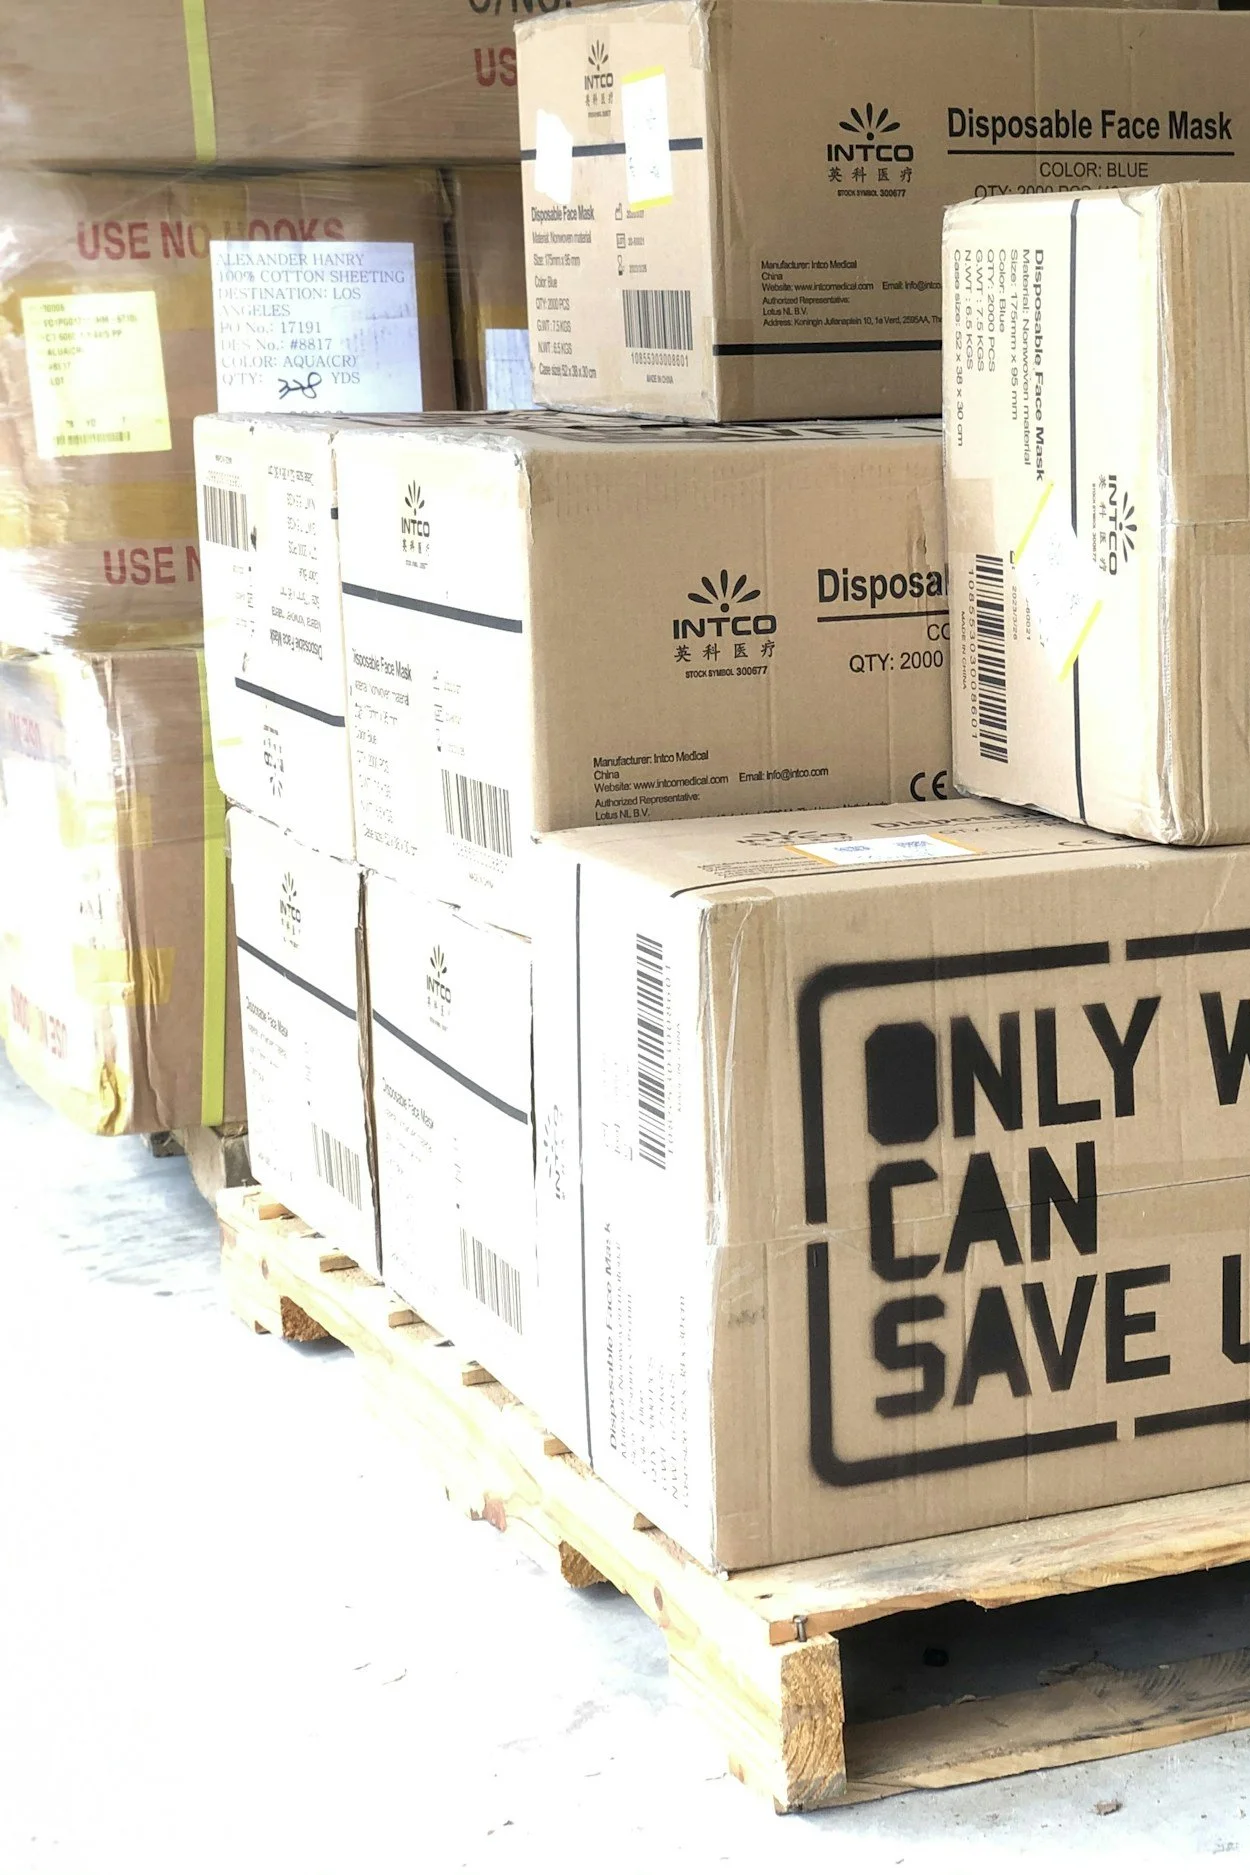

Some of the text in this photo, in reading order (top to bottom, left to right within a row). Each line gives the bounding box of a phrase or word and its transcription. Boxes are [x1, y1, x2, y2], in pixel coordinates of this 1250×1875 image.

[584, 72, 614, 90] INTCO
[946, 107, 1232, 145] Disposable Face Mask
[827, 144, 914, 162] INTCO
[828, 166, 913, 183] 英科医疗
[1039, 162, 1149, 178] COLOR: BLUE
[837, 189, 855, 197] STOCK
[879, 189, 906, 198] 300677
[531, 205, 595, 224] Disposable Face Mask
[78, 220, 150, 260] USE
[216, 252, 364, 266] ALEXANDER HANRY
[811, 260, 828, 269] Intco
[830, 260, 858, 269] Medical
[218, 270, 406, 284] 100% COTTON SHEETING
[547, 276, 558, 289] Blue
[761, 272, 783, 281] China
[218, 287, 361, 300] DESTINATION: LOS
[762, 282, 874, 292] Website: www.intcomedical.com
[998, 249, 1006, 332] Color: Blue
[762, 296, 799, 305] Authorized
[964, 249, 974, 370] N.WT 6.5 KGS
[218, 304, 291, 317] ANGELES
[762, 307, 781, 316] Lotus
[975, 249, 984, 372] G.WT 7.5 KGS
[987, 249, 995, 372] QTY: 2000 PCS
[280, 321, 321, 334] 17191
[763, 318, 823, 327] Address: Koningin
[1010, 249, 1018, 420] Size: 175mm x 95 mm
[290, 338, 332, 351] #8817
[954, 249, 964, 447] Case size: 52 38 30 cm
[221, 354, 357, 368] COLOR: AQUA(CR)
[630, 351, 689, 368] 10855303008601
[1022, 249, 1032, 466] Material: Nonwoven material
[1033, 249, 1045, 481] Disposable Face Mask
[331, 372, 360, 384] YDS
[401, 516, 430, 538] INTCO
[1108, 474, 1117, 576] INTCO
[103, 546, 176, 585] USE
[817, 563, 949, 608] Disposa
[672, 614, 777, 640] INTCO
[674, 640, 776, 663] 英科医疗
[968, 568, 978, 740] 10855303008601
[352, 650, 412, 682] isposable Face Mask
[849, 650, 944, 673] QTY: 2000
[685, 665, 768, 679] STOCK SYMBOL 300677
[593, 750, 708, 768] Manufacturer: Intco Medical
[593, 769, 619, 780] China
[594, 771, 764, 793] Website: www.intcomedical.com Email:
[594, 795, 638, 808] Authorized
[595, 810, 618, 821] Lotus
[619, 809, 631, 819] NL
[426, 974, 451, 1004] INTCO
[864, 994, 1162, 1146] ONLY
[869, 1140, 1098, 1283] CAN
[873, 1264, 1172, 1418] SAVE
